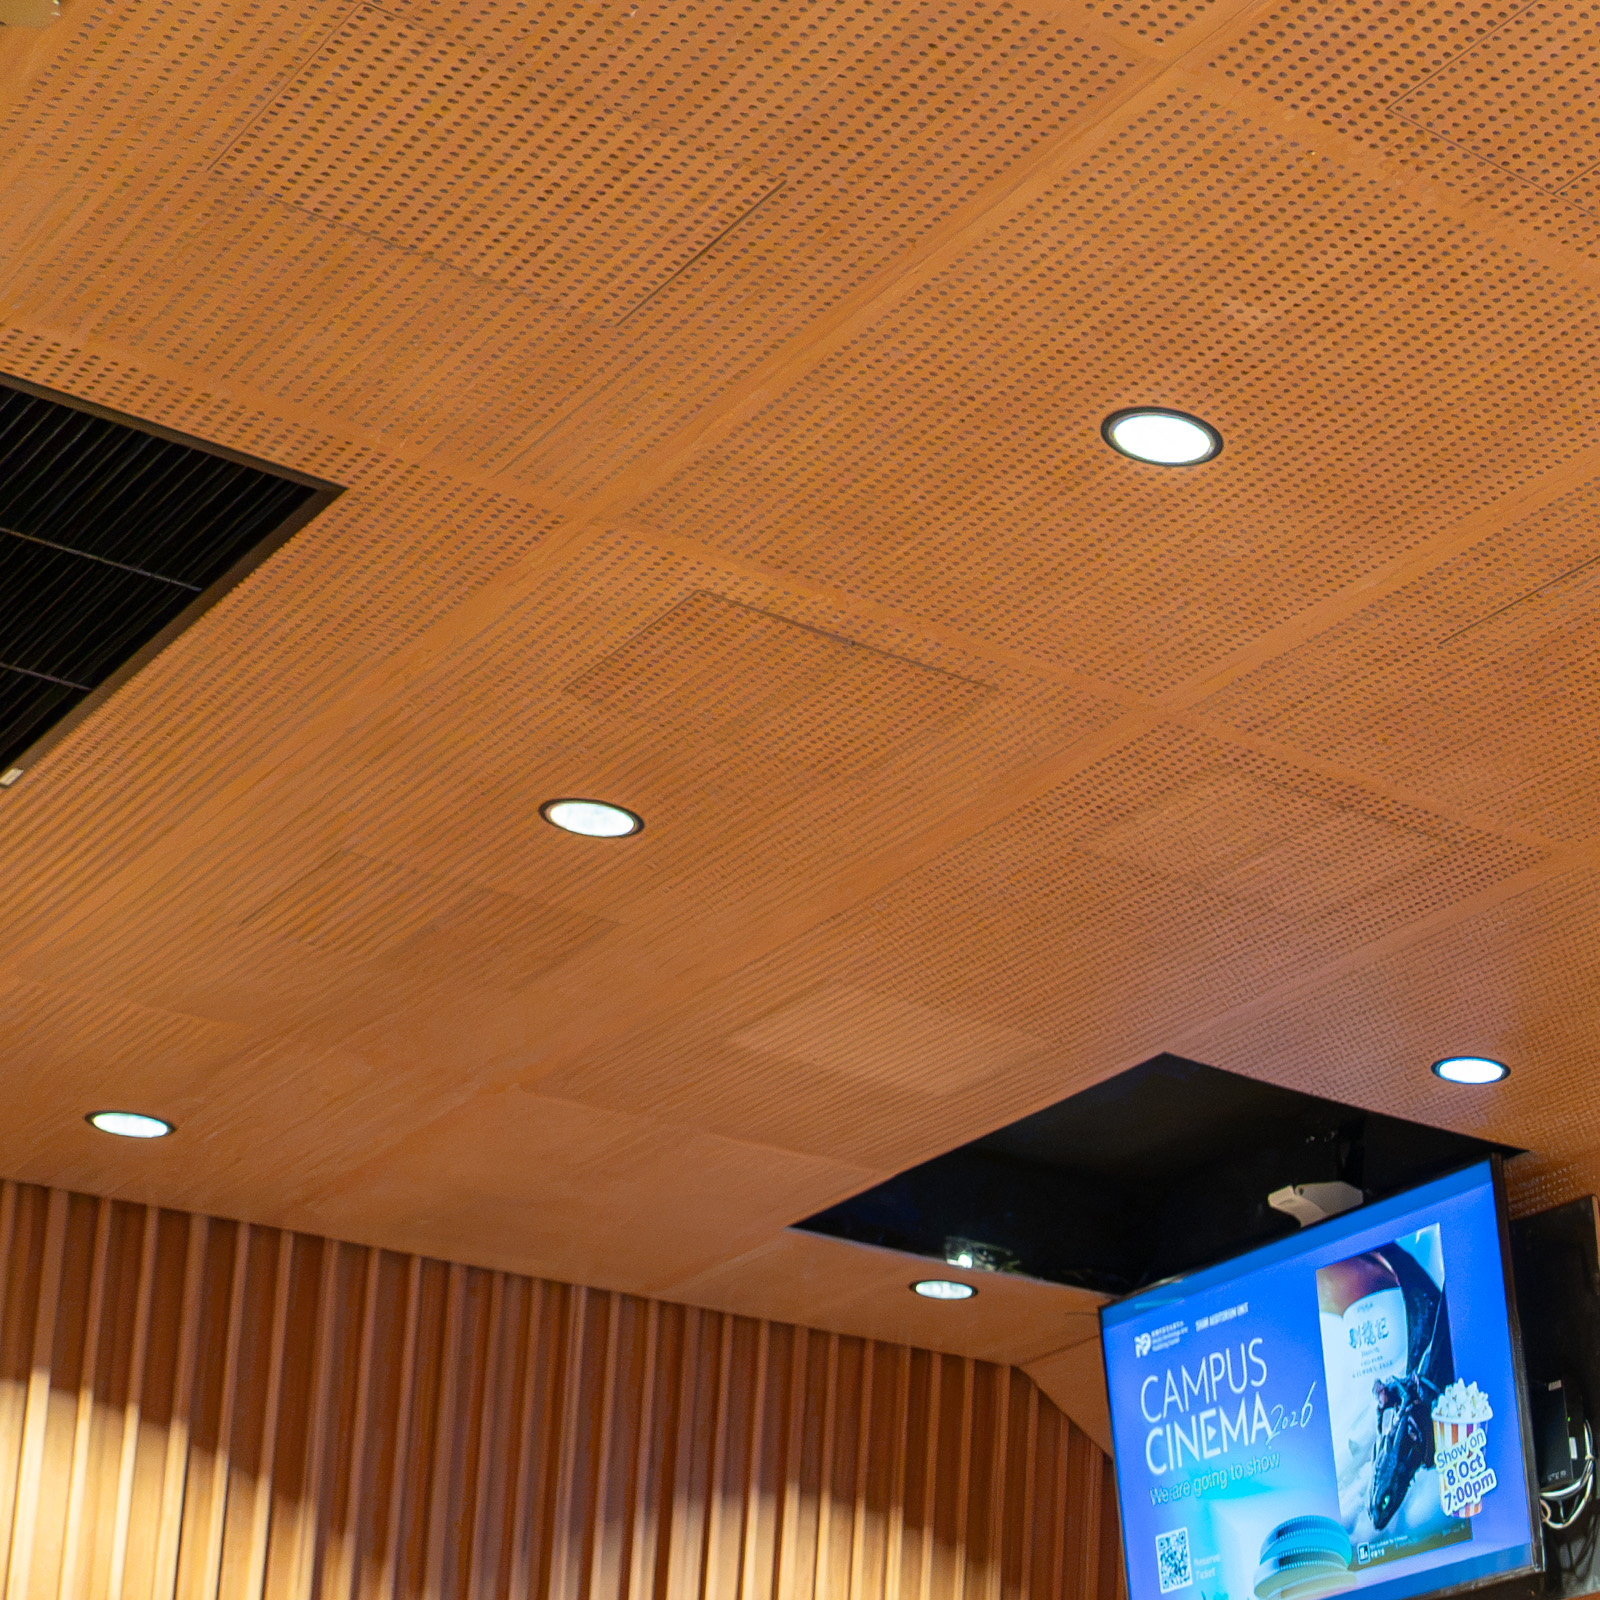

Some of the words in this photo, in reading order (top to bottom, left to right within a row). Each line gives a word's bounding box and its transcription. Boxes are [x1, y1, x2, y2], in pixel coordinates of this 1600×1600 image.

[1141, 1338, 1267, 1423] CAMPUS
[1146, 1391, 1272, 1475] CINEMA
[1266, 1381, 1317, 1446] 2026
[1437, 1442, 1467, 1469] Show
[1470, 1432, 1484, 1448] on
[1150, 1486, 1169, 1506] We
[1170, 1481, 1191, 1498] are
[1194, 1467, 1228, 1496] going
[1230, 1464, 1245, 1480] to
[1247, 1452, 1281, 1475] show
[1444, 1473, 1494, 1512] 7:00pm
[1447, 1469, 1456, 1486] 8
[1459, 1453, 1483, 1478] Oct
